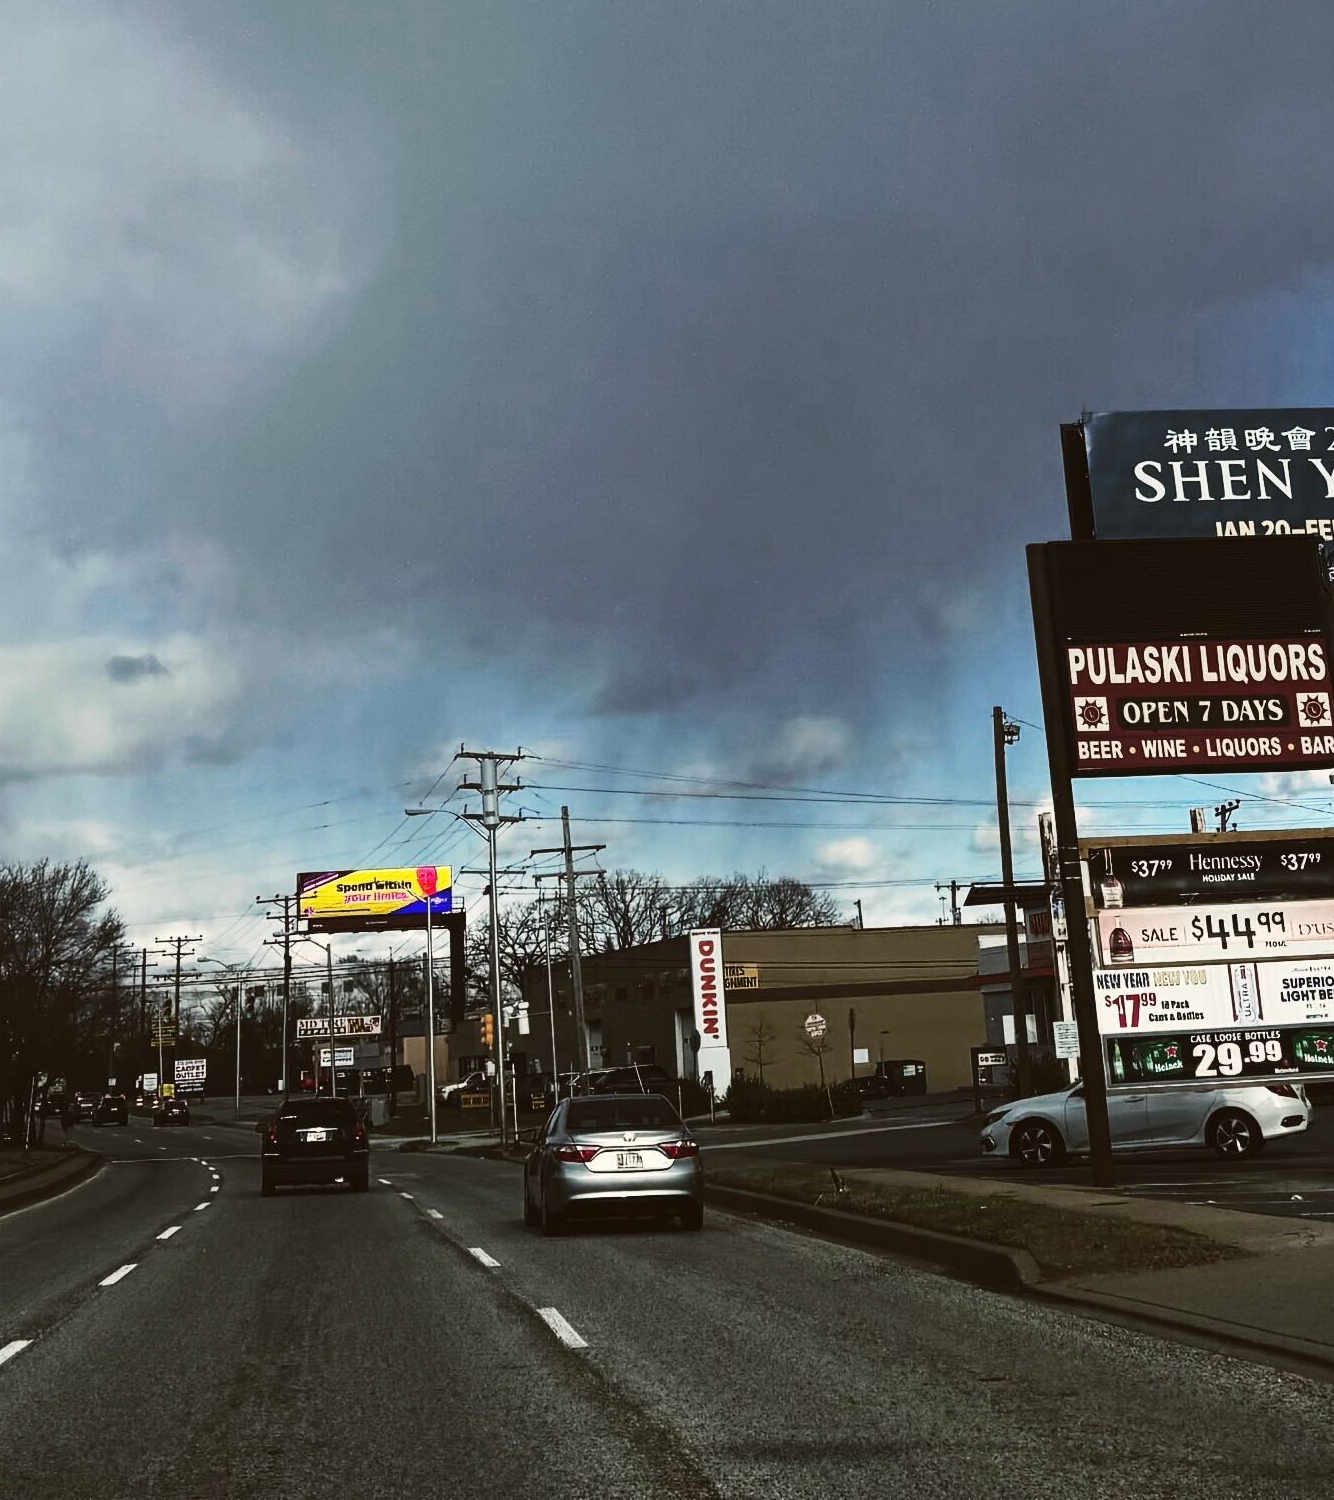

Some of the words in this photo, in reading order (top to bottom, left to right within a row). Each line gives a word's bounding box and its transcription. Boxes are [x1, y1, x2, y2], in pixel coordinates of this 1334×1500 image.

[1163, 426, 1316, 454] 神韻晚會
[1134, 458, 1293, 502] SHEN
[1068, 646, 1192, 685] PULASKI
[1200, 643, 1326, 684] LIQUORS
[1123, 701, 1190, 723] OPEN
[1198, 701, 1211, 721] 7
[1221, 699, 1283, 721] DAYS
[1077, 740, 1123, 760] BEER
[1141, 739, 1187, 758] WINE
[1205, 737, 1282, 758] LIQUORS
[1189, 853, 1263, 872] Hennessy
[1202, 873, 1236, 883] HOLIDAY
[1237, 872, 1255, 881] SALE
[1141, 927, 1179, 942] SALE
[698, 939, 720, 1040] DUNKIN'
[725, 976, 756, 988] GNMENT
[1096, 973, 1121, 989] NEW
[1122, 972, 1150, 989] YEAR
[1241, 983, 1252, 1017] ULTRA
[1280, 990, 1316, 1002] LIGHT
[1190, 1034, 1211, 1044] CASE
[1214, 1032, 1242, 1042] LOOSE
[1245, 1030, 1281, 1041] BOTTLES
[1192, 1040, 1283, 1077] 29.99
